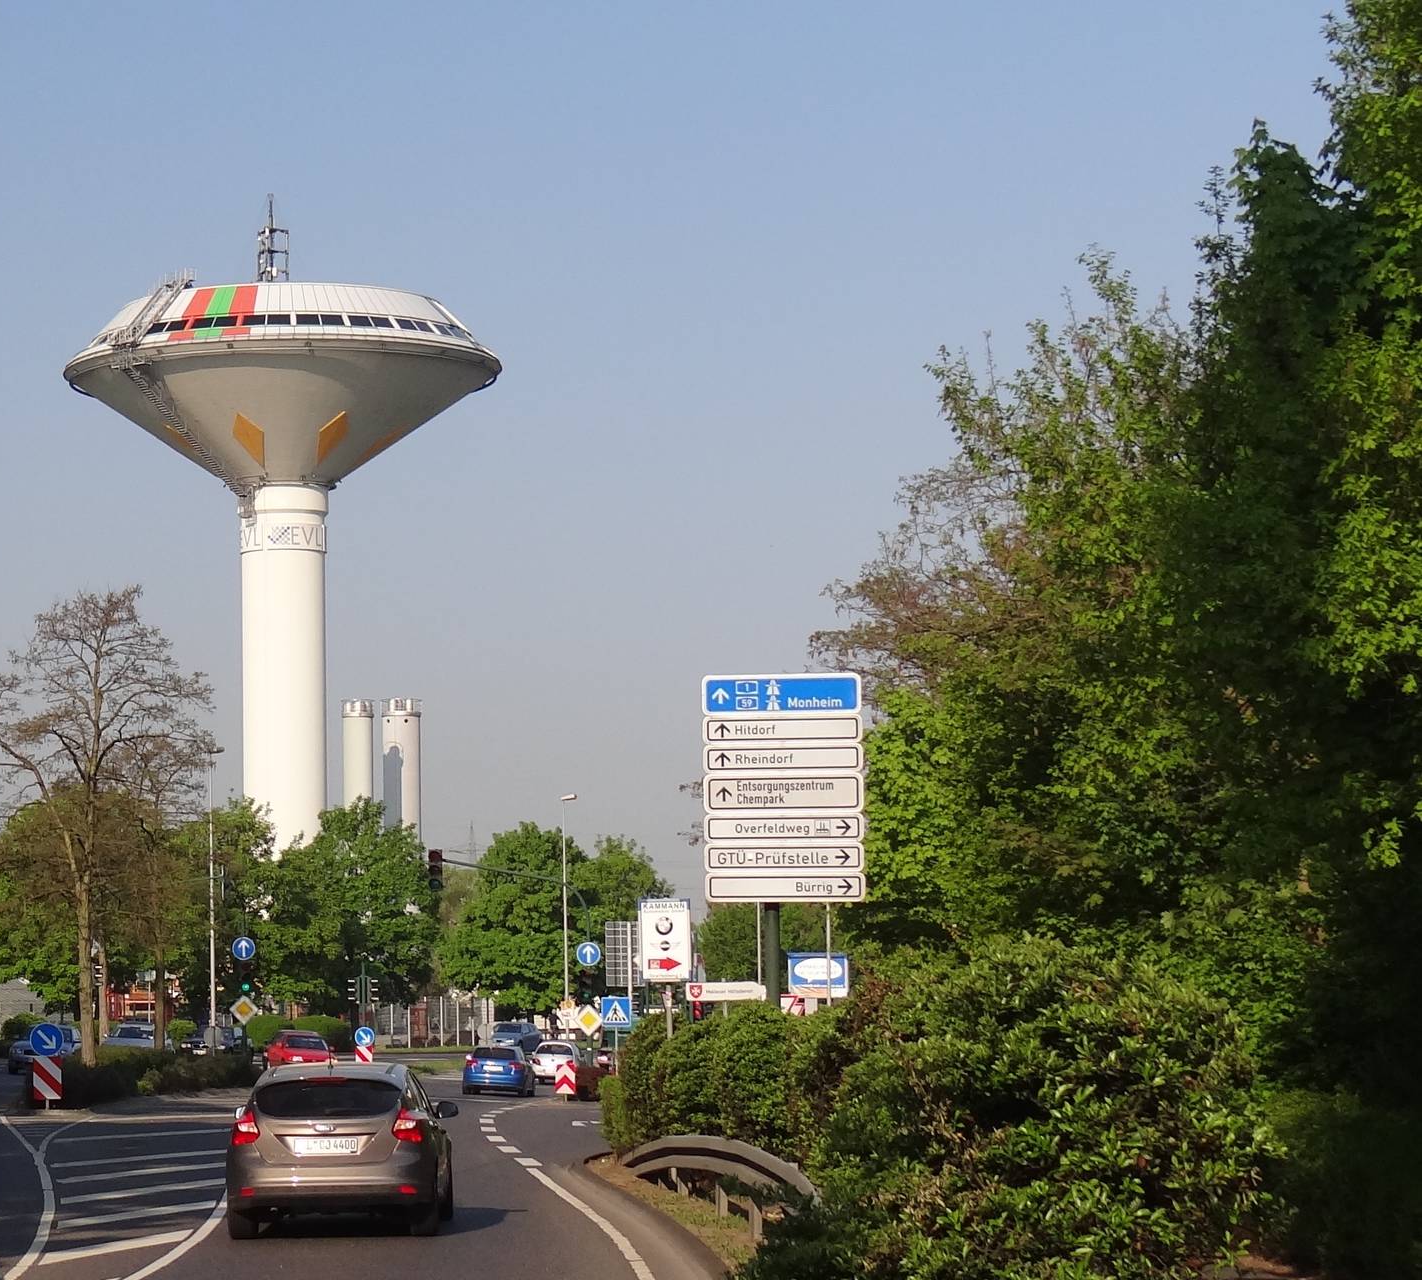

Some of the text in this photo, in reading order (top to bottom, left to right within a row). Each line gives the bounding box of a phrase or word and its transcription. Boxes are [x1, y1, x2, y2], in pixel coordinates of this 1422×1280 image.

[291, 526, 322, 547] EVL
[744, 683, 750, 692] 1
[741, 699, 753, 708] 59
[787, 696, 843, 709] Monheim
[734, 725, 776, 736] Hitdorf
[735, 753, 794, 765] Rheindorf
[736, 780, 835, 794] Entsorgungszentrum
[736, 793, 785, 807] Chempark
[734, 822, 810, 835] Overfeldweg
[717, 849, 829, 865] GTÜ-Prüfstelle
[795, 880, 833, 894] Bürrig
